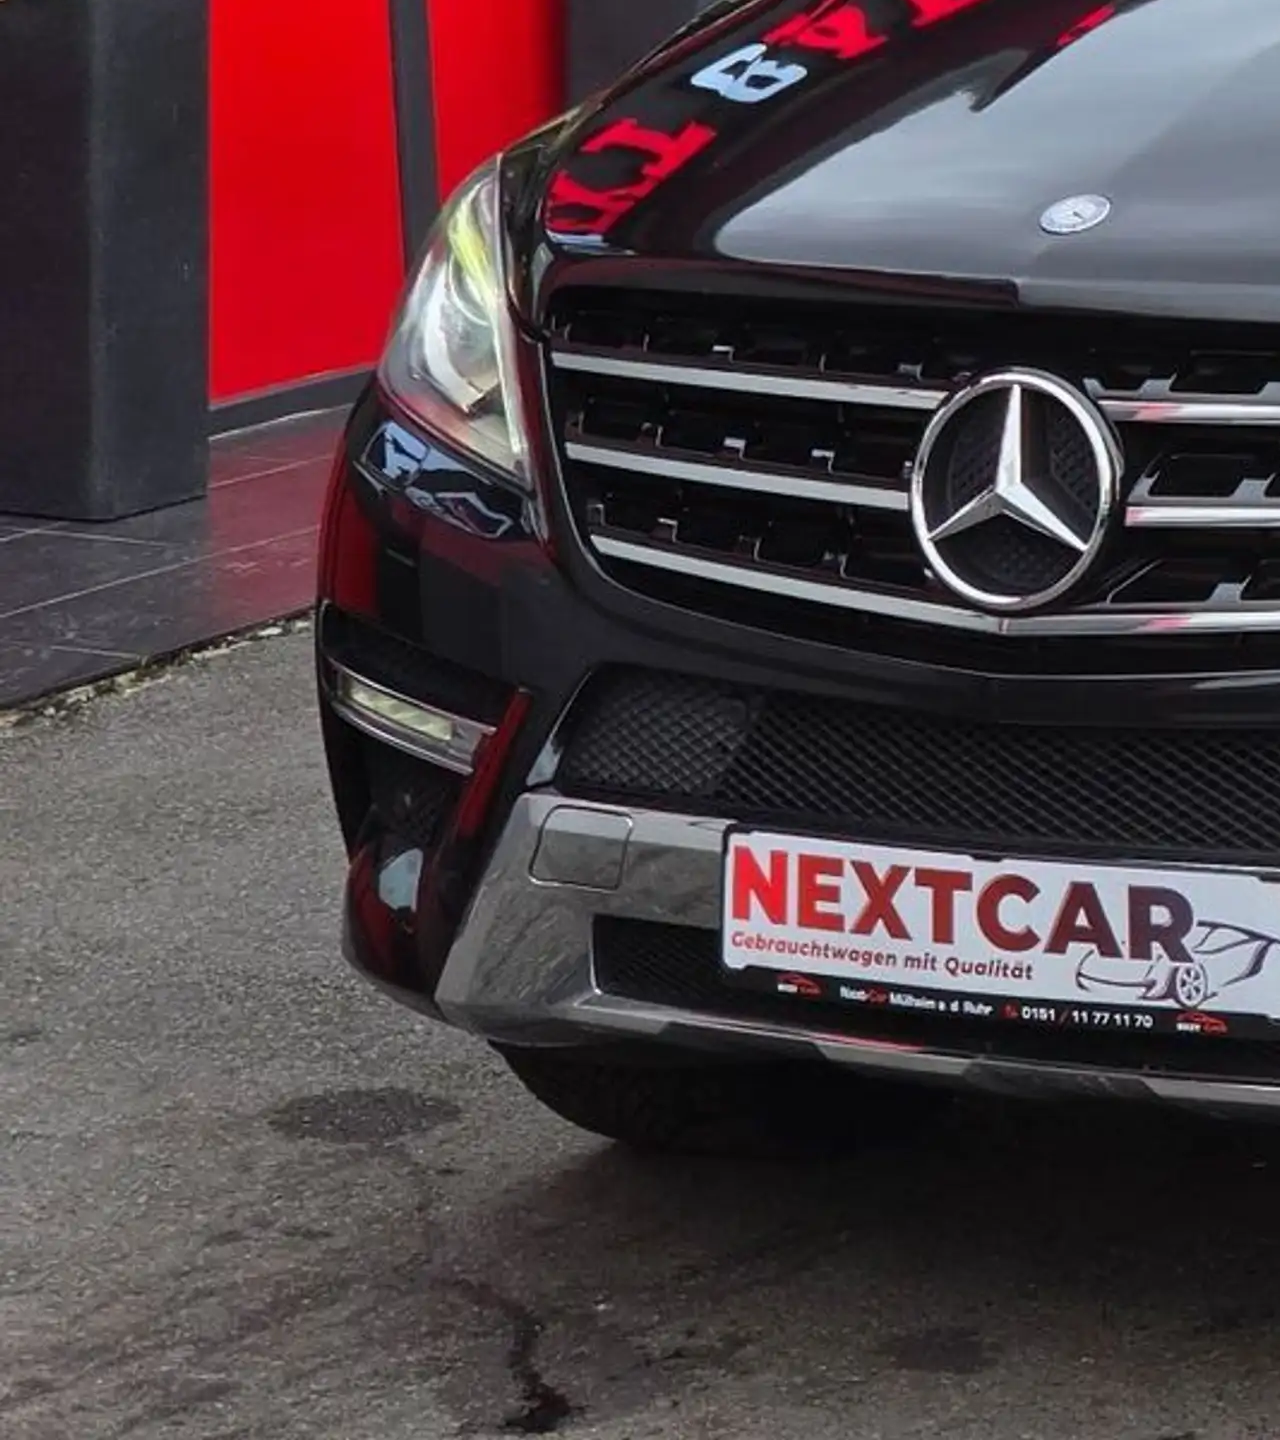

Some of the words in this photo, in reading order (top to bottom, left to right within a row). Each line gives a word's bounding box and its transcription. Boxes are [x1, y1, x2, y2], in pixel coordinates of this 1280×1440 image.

[732, 845, 1195, 963] NEXTCAR
[731, 931, 897, 968] Gebrauchtwagen
[903, 951, 937, 971] mit
[943, 956, 1034, 981] Qualität
[1021, 1005, 1056, 1022] 0151
